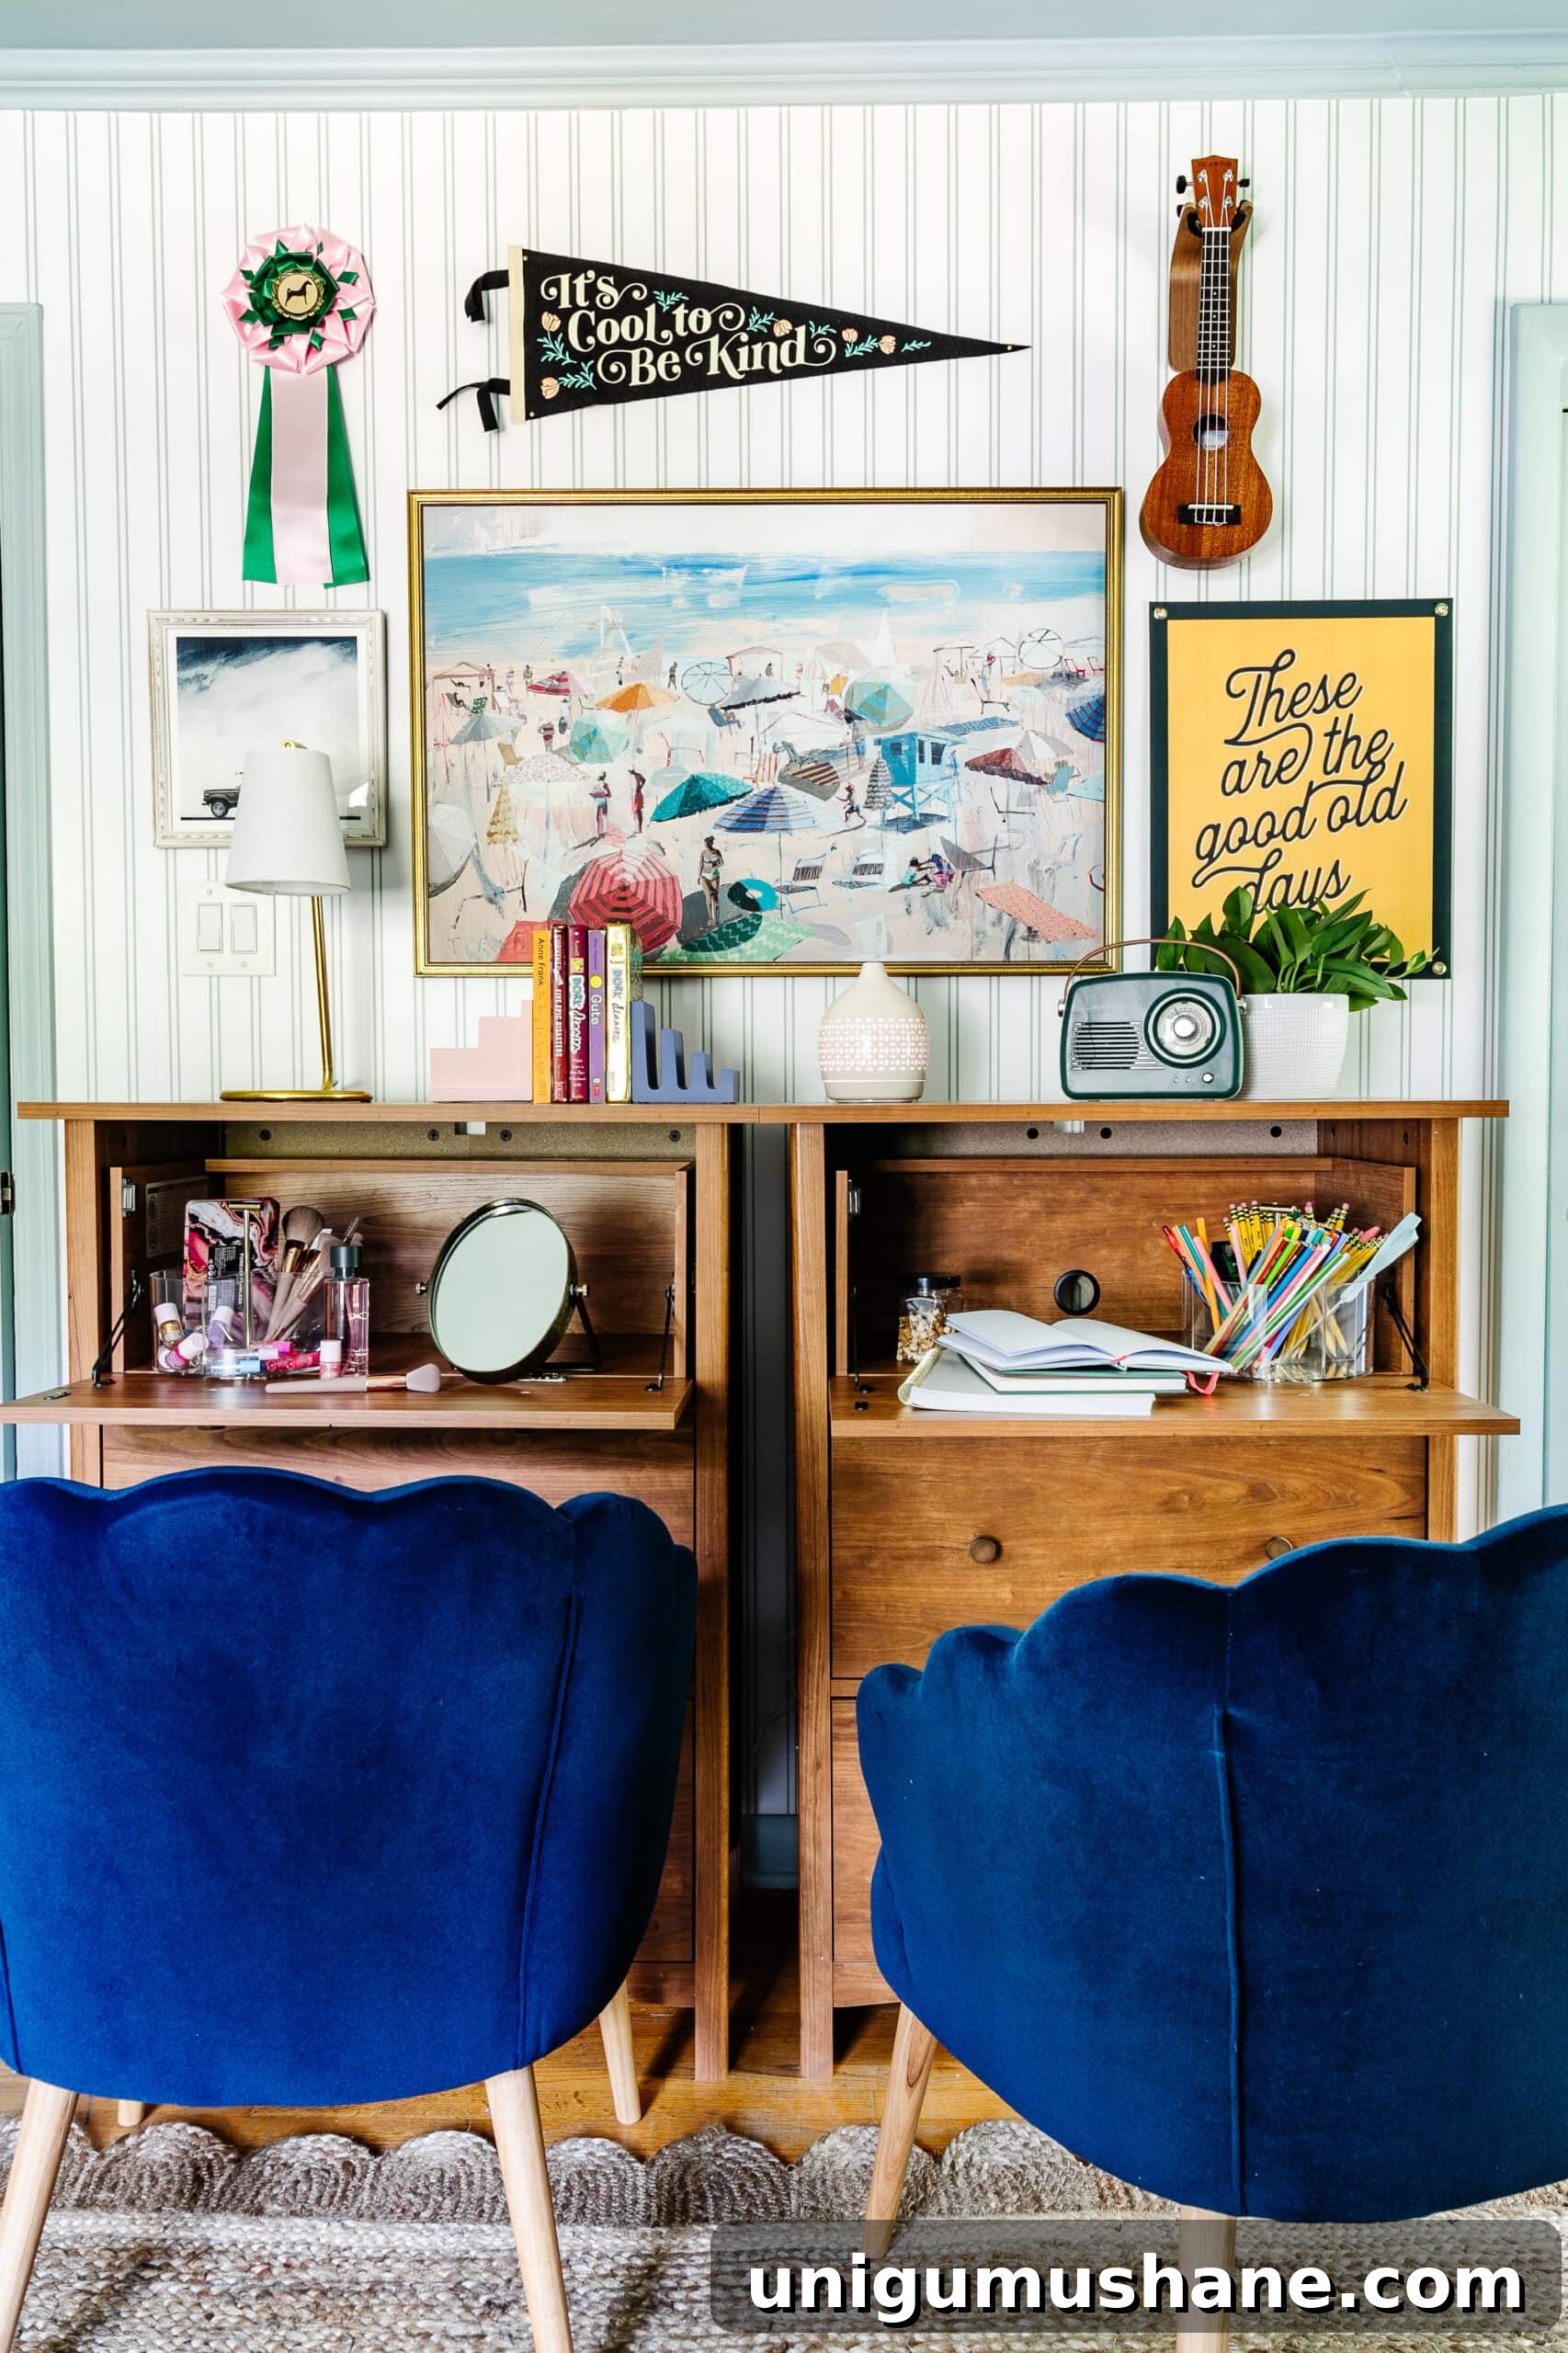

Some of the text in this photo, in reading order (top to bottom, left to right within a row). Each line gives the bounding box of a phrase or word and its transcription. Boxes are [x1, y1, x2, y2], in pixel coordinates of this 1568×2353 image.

[540, 269, 648, 310] It's
[566, 302, 745, 352] Cool to
[597, 324, 836, 387] Be Kind
[1224, 649, 1363, 745] These
[1221, 713, 1394, 797] are the
[1193, 761, 1408, 886] good old
[1239, 847, 1351, 914] days
[537, 962, 545, 986] Frank
[572, 976, 584, 1007] DORK
[612, 969, 624, 999] DORK
[590, 994, 602, 1026] Guts
